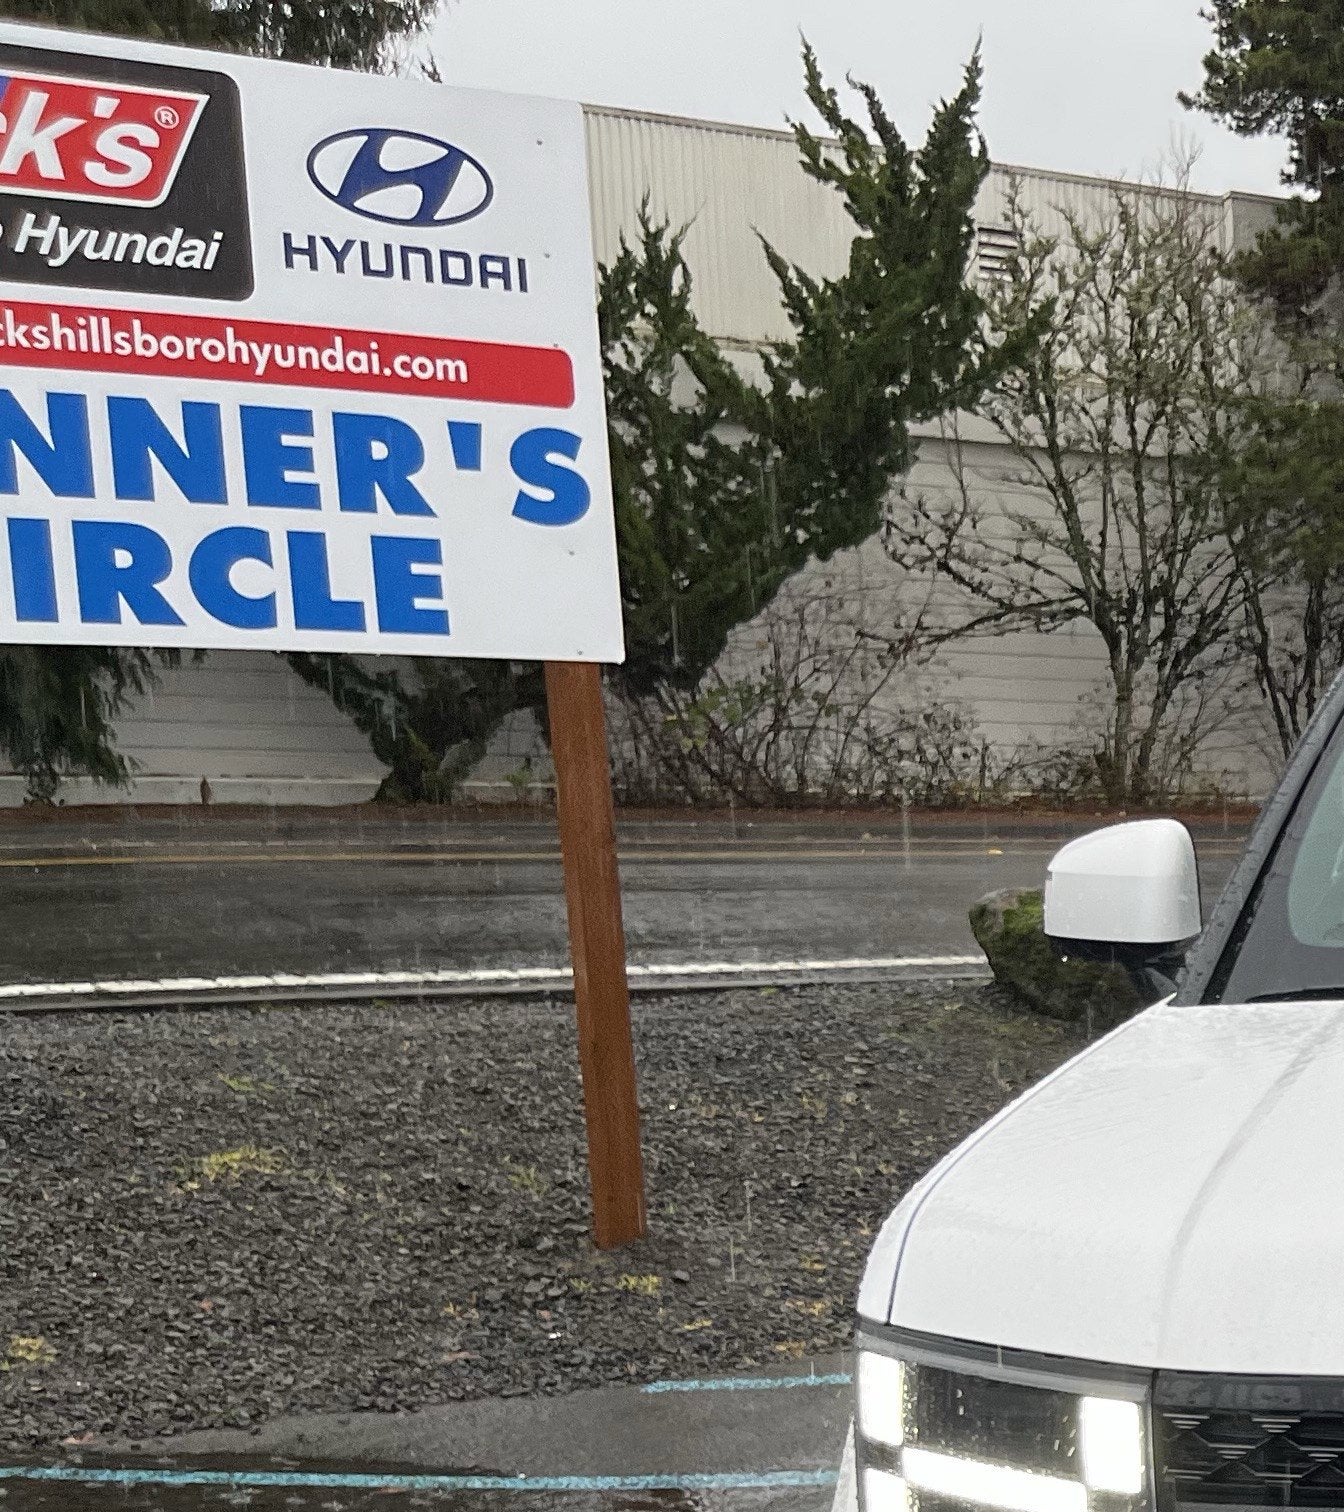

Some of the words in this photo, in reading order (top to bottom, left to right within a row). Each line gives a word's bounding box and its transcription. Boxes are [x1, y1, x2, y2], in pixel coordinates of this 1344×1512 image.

[14, 213, 223, 271] Hyundai
[282, 232, 529, 293] HYUNDAI
[0, 388, 591, 527] NNER'S
[8, 516, 451, 636] IRCLE
